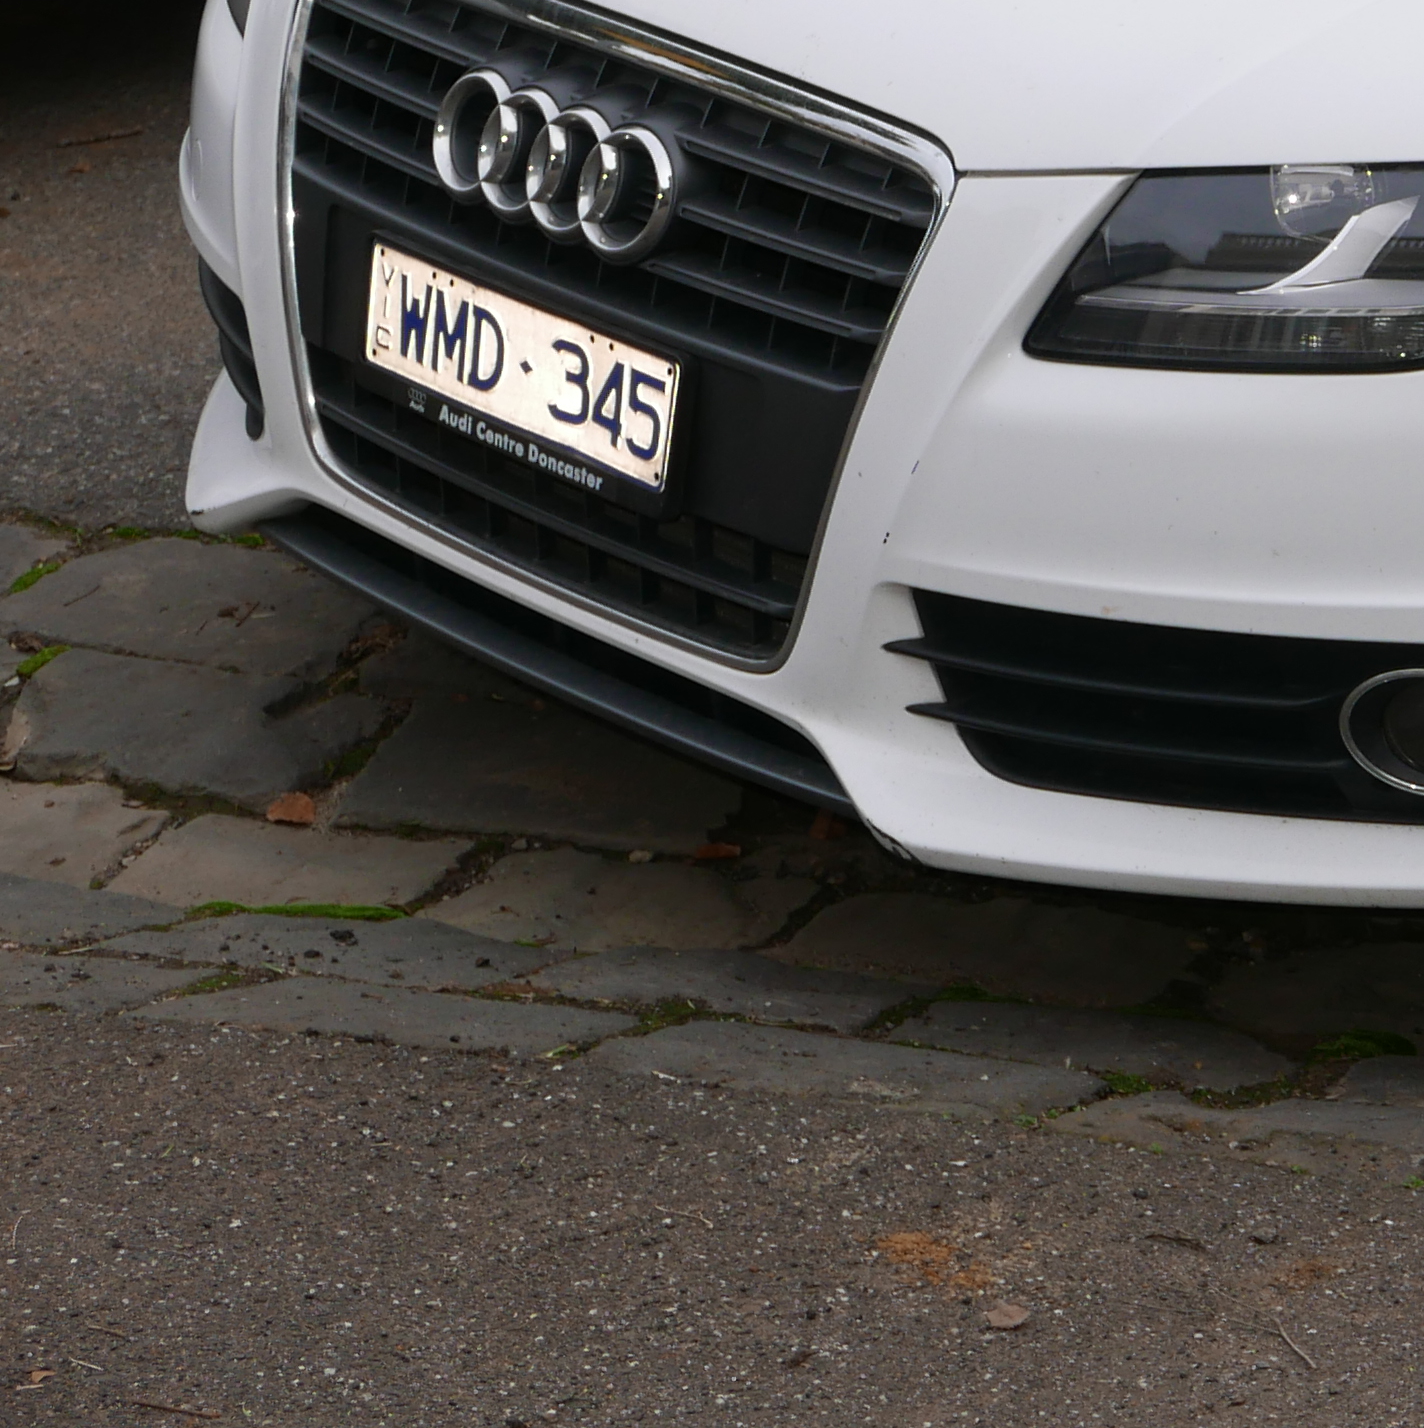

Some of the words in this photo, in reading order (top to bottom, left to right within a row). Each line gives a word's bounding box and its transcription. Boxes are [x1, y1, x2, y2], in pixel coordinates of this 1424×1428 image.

[376, 263, 396, 349] VIC
[439, 403, 473, 435] Audi
[476, 421, 524, 458] Centre
[528, 443, 603, 491] Doncaster
